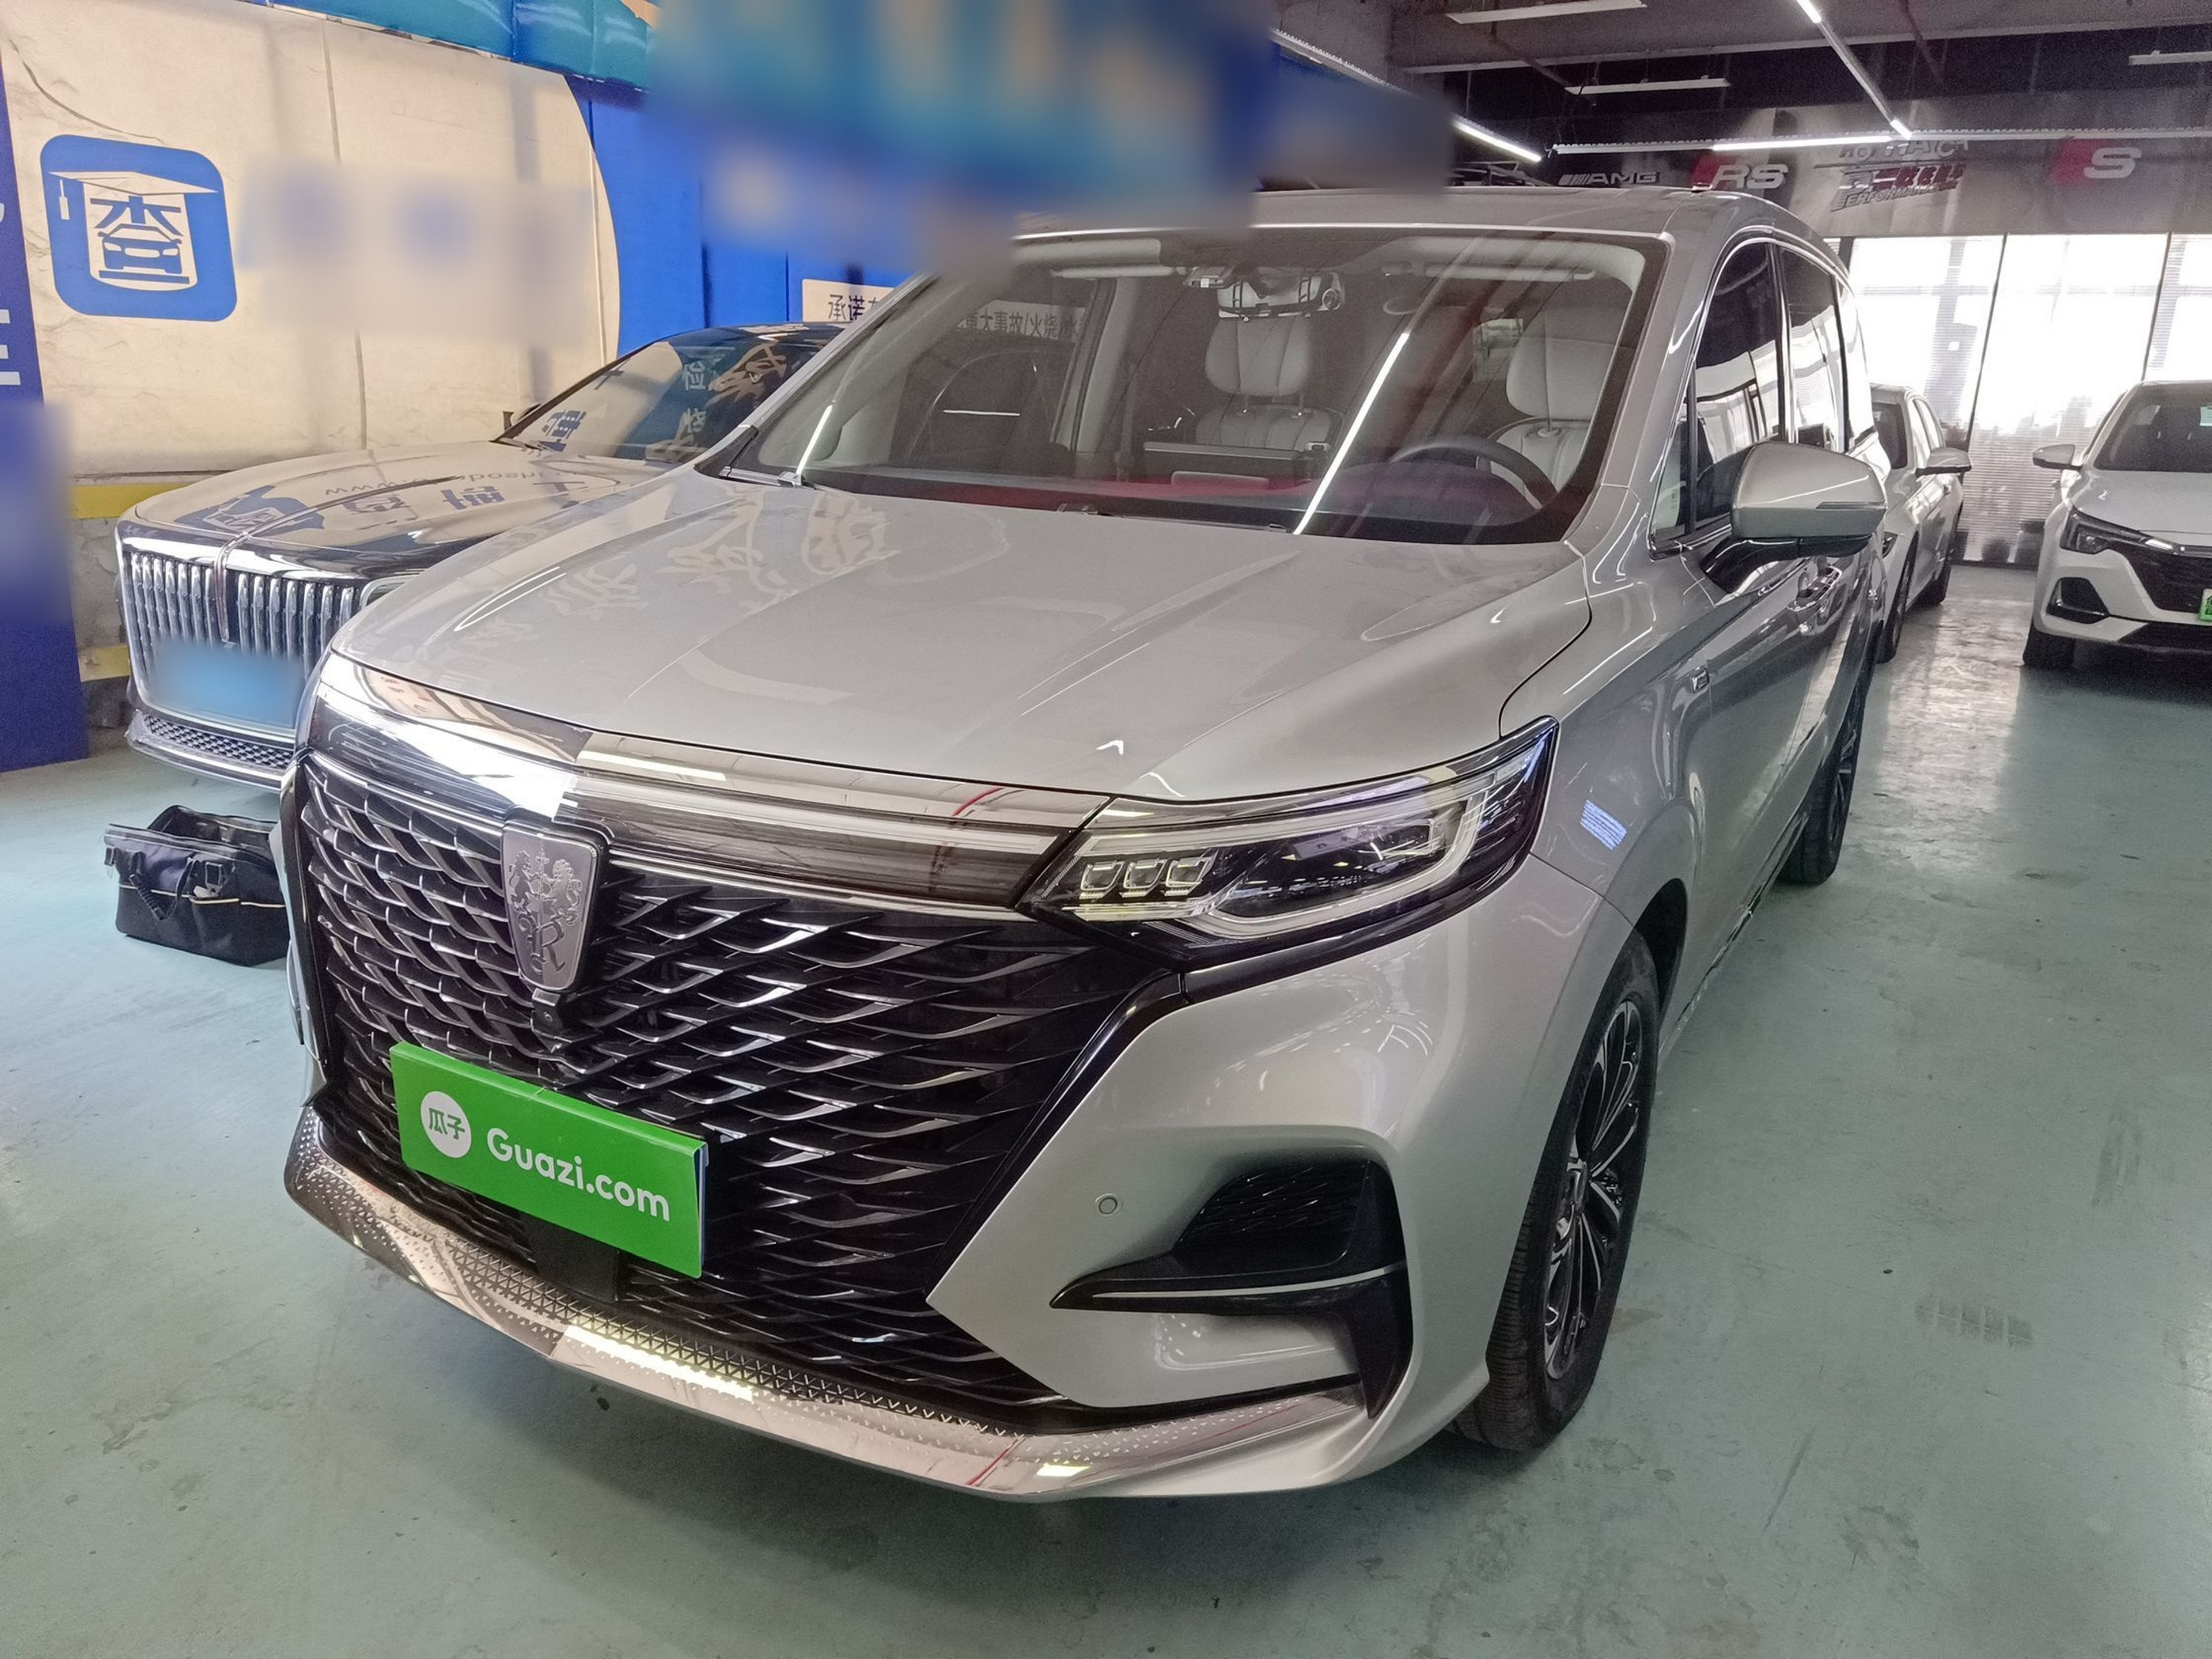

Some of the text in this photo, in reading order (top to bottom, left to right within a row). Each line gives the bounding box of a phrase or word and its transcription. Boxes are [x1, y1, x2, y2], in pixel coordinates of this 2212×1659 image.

[1586, 172, 1658, 185] AMG
[1709, 164, 1789, 190] RS
[2084, 147, 2142, 179] S
[428, 1107, 465, 1139] 瓜子
[487, 1127, 670, 1222] Guazi.com
